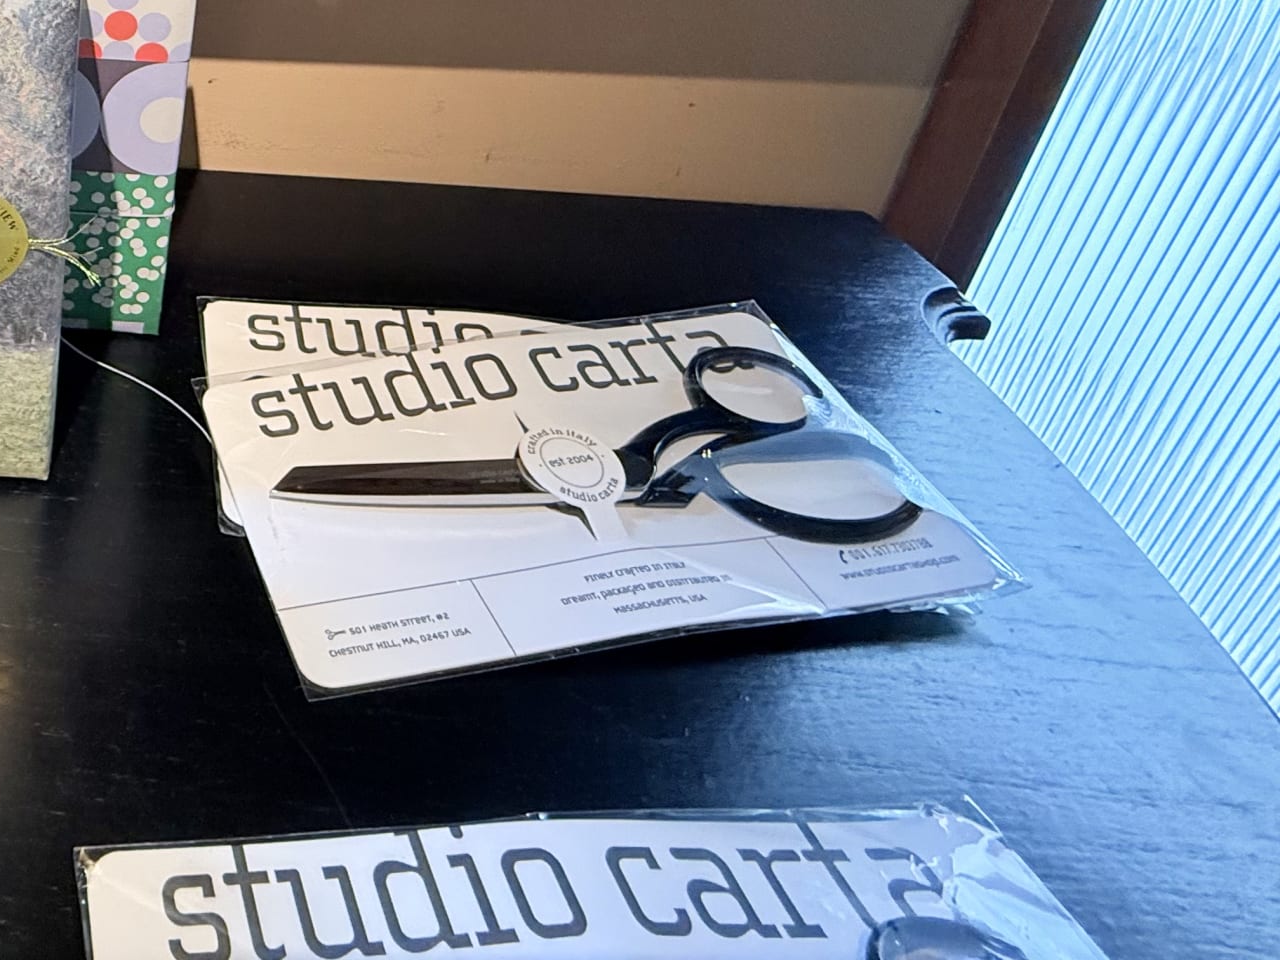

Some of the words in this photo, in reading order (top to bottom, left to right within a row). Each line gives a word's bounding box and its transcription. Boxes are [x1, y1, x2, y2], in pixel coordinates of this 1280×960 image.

[251, 351, 517, 438] studio
[528, 318, 755, 392] carta
[567, 453, 594, 466] 2004
[560, 485, 598, 503] studio
[599, 477, 619, 501] carta
[348, 626, 367, 636] 501
[376, 639, 402, 650] HILL,
[402, 635, 419, 646] MA,
[420, 630, 450, 643] 02467
[452, 626, 473, 638] USA
[162, 825, 587, 960] studio
[605, 810, 946, 939] carta
